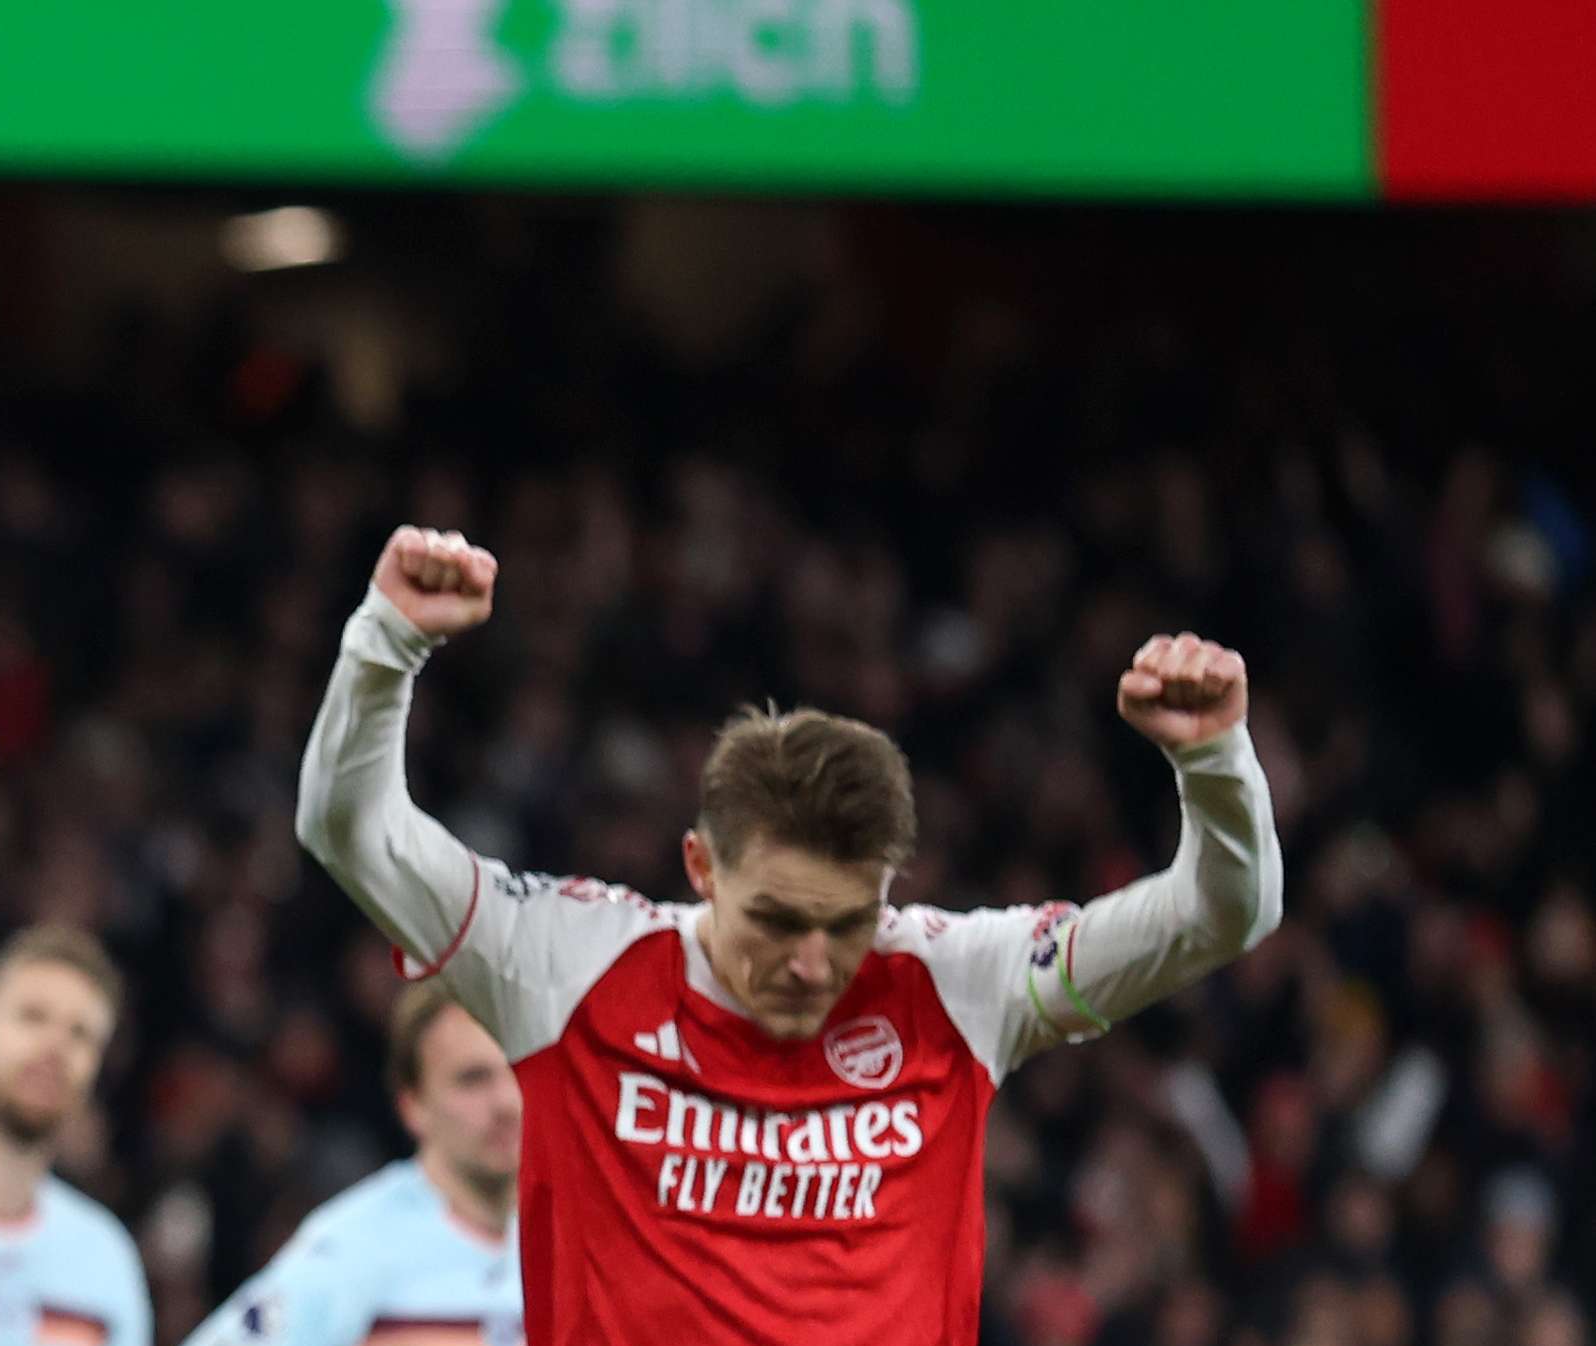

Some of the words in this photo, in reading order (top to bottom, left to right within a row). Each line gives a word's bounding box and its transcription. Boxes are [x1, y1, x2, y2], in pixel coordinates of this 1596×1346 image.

[614, 1071, 924, 1162] Emirates
[658, 1153, 728, 1213] FLY
[734, 1158, 883, 1221] BETTER
